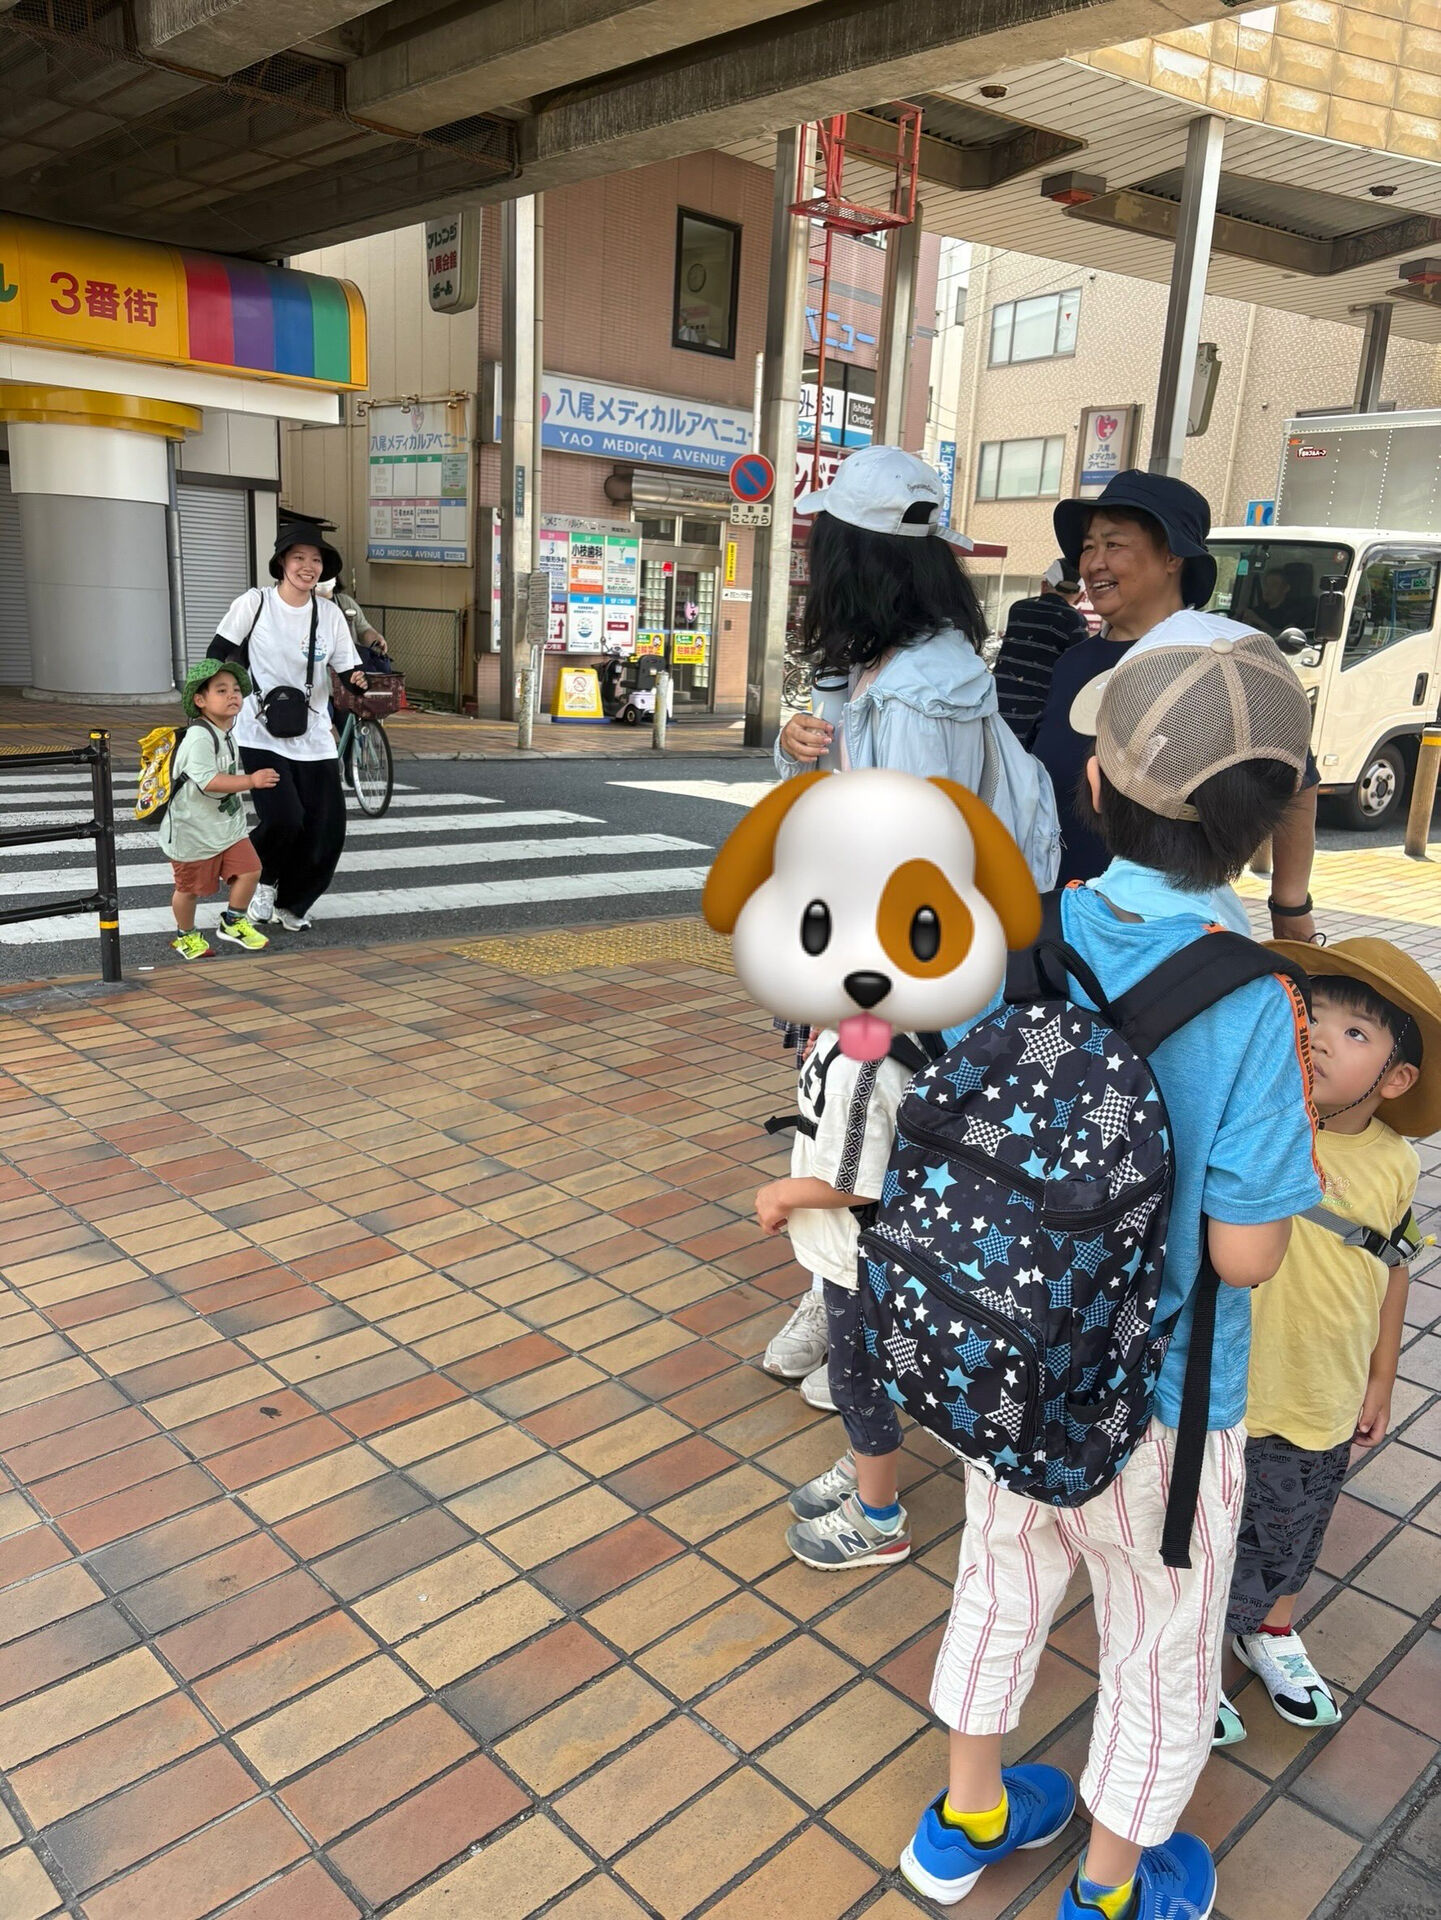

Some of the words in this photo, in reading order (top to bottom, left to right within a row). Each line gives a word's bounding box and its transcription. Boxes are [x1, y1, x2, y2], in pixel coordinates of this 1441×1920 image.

[50, 271, 159, 328] 3番街
[556, 388, 752, 446] 八尾メディカルアベニュ
[559, 431, 593, 447] YAO
[673, 450, 727, 467] AVENUE
[732, 513, 769, 525] ここから
[387, 549, 413, 558] MEDICAL
[836, 1530, 872, 1556] N
